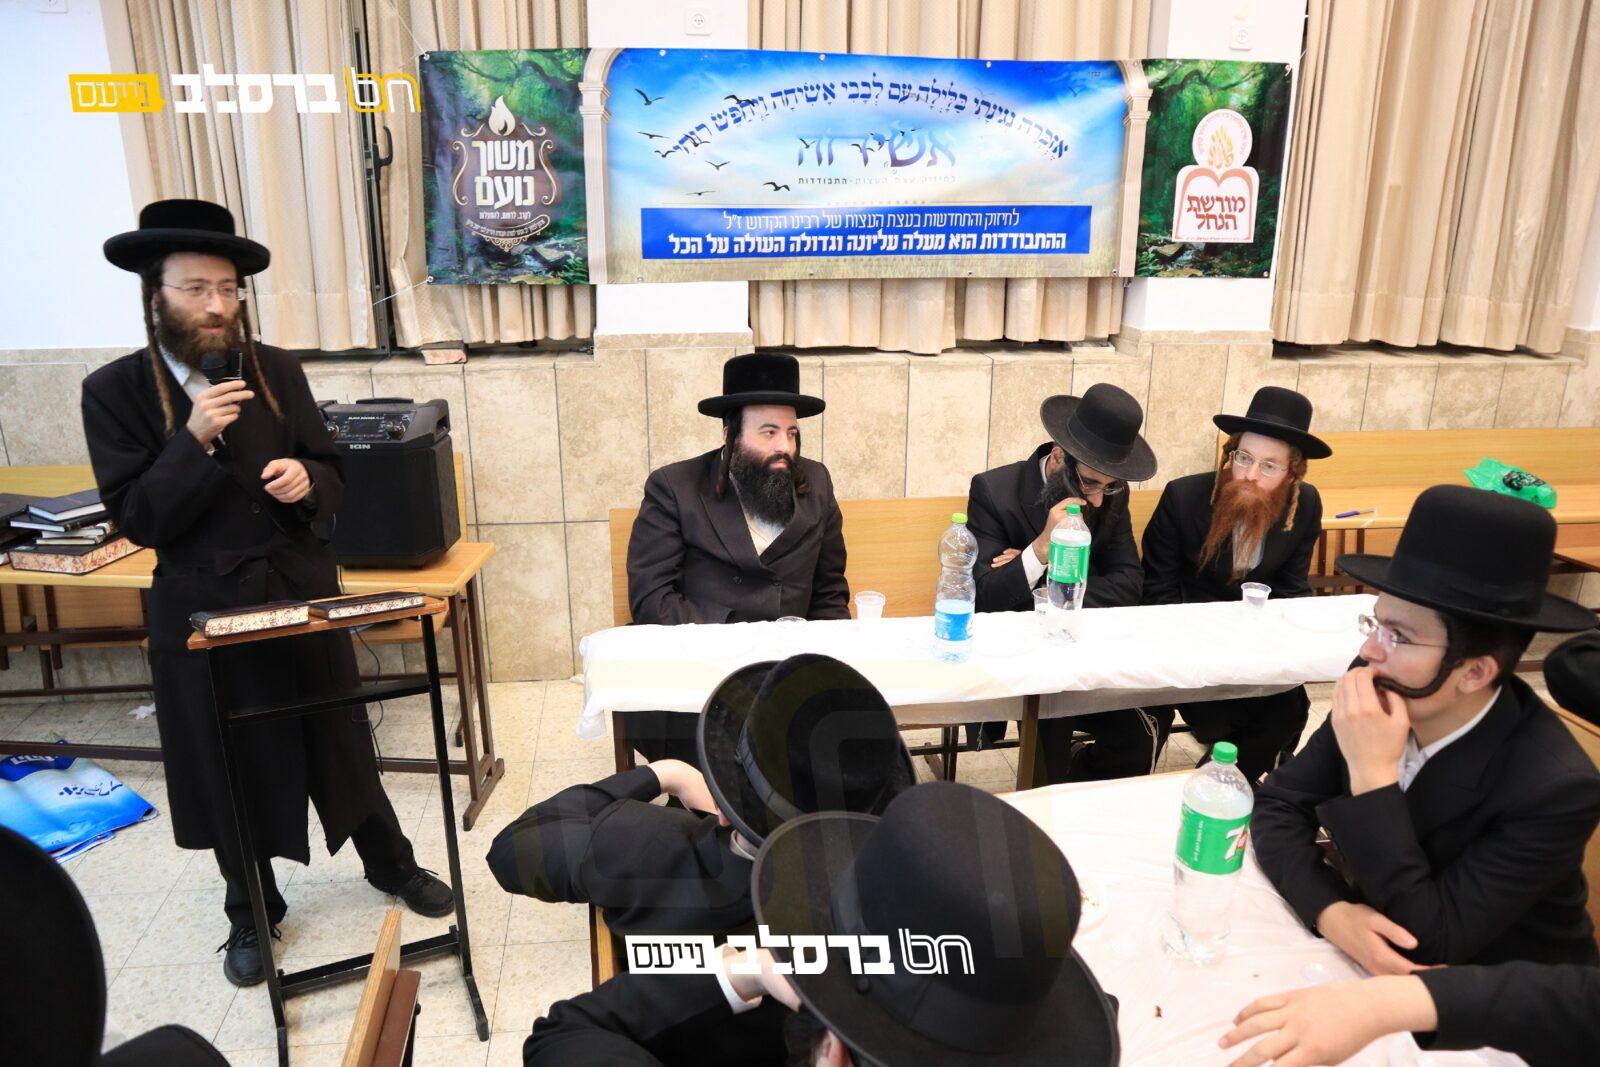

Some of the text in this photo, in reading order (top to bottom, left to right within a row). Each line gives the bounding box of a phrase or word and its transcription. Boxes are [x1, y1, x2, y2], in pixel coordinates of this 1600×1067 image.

[771, 82, 836, 110] אשיחה
[841, 72, 884, 105] לבבי
[888, 82, 912, 103] עם
[472, 140, 536, 177] משוך
[474, 175, 536, 209] נועם
[1187, 194, 1246, 213] מורשת
[746, 214, 788, 233] הקדוש
[791, 215, 820, 229] רבינו
[822, 210, 842, 229] של
[845, 213, 884, 229] העצות
[887, 213, 921, 228] בעצת
[924, 212, 983, 228] והתחדשות
[984, 208, 1020, 230] לחיזוק
[1195, 211, 1238, 230] הנחל
[668, 229, 1067, 255] ההתבודדות הוא מעלה עליונה וגדולה העולה על הכל
